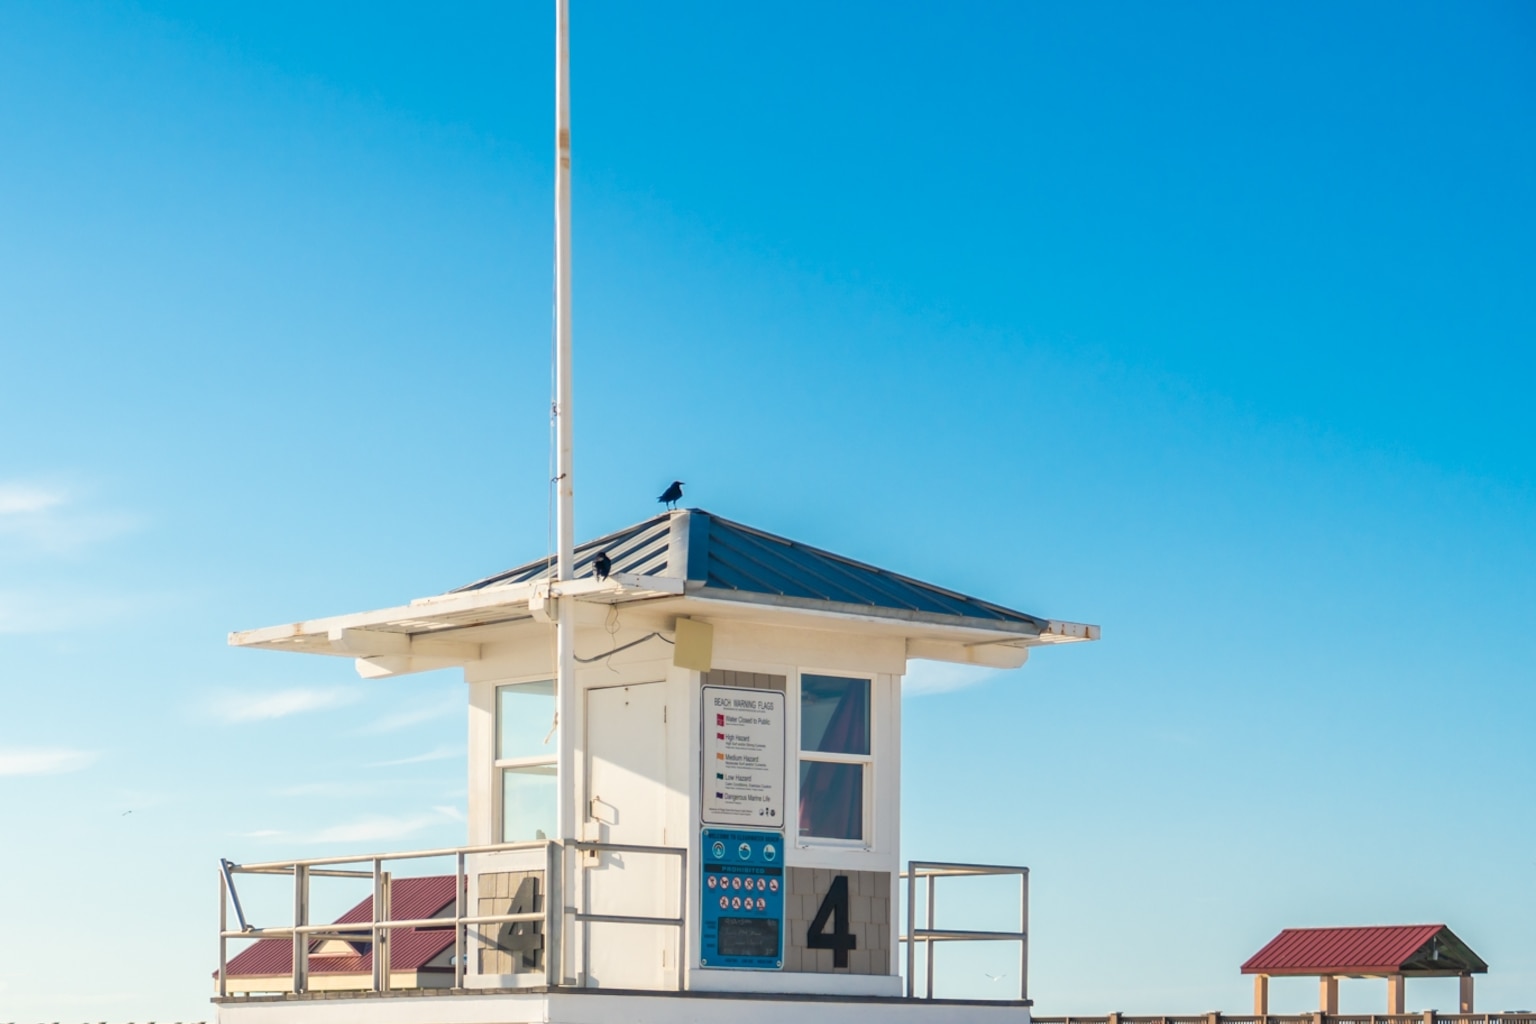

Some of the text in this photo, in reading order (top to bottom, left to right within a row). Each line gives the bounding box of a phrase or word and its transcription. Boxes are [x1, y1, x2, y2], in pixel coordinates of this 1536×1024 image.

[714, 697, 732, 707] BEACH
[733, 699, 757, 709] WARNING
[757, 700, 774, 711] FLAGS
[735, 734, 750, 742] Hazard
[725, 753, 759, 763] Medium Hazard
[725, 773, 752, 782] Low Hazard
[724, 792, 747, 801] Dangerous
[747, 794, 762, 802] Marine
[721, 865, 765, 874] PROHIBITED
[497, 876, 542, 967] 4
[807, 875, 857, 968] 4
